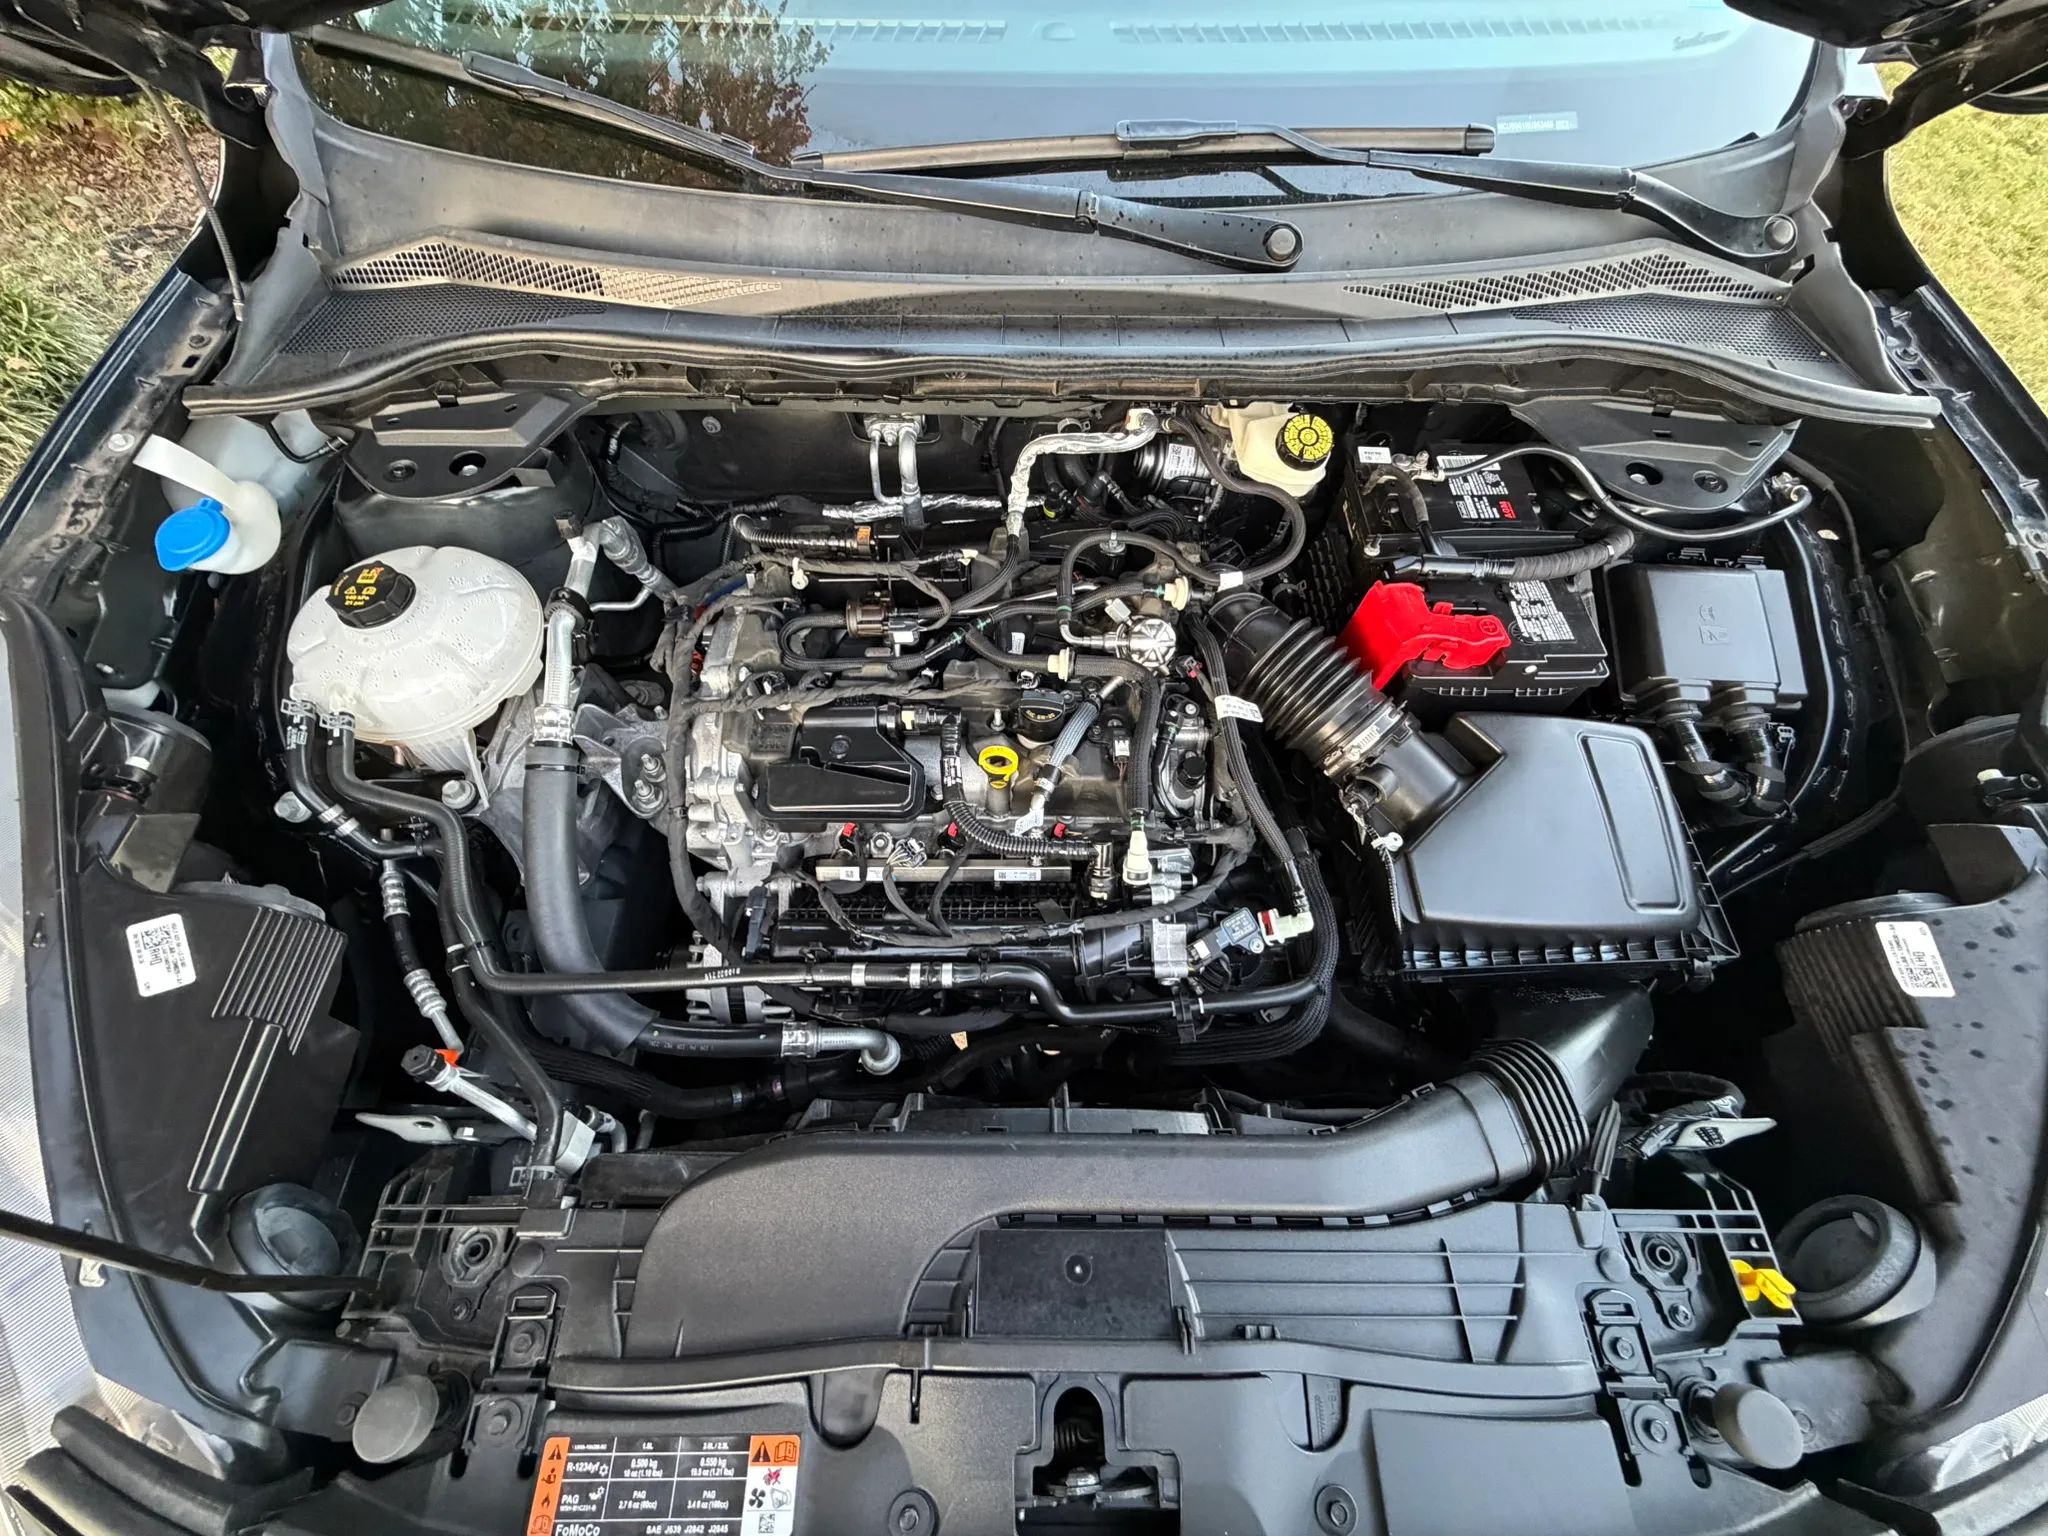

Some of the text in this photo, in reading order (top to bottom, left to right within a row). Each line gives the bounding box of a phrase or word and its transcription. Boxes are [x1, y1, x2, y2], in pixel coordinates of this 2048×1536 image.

[566, 1461, 600, 1473] R-1234yf
[649, 1458, 658, 1470] kg
[718, 1457, 727, 1468] kg
[561, 1494, 579, 1504] PAG
[632, 1490, 647, 1499] PAG
[702, 1490, 716, 1499] PAG
[555, 1523, 601, 1536] FoMoCo
[646, 1524, 662, 1534] SAE
